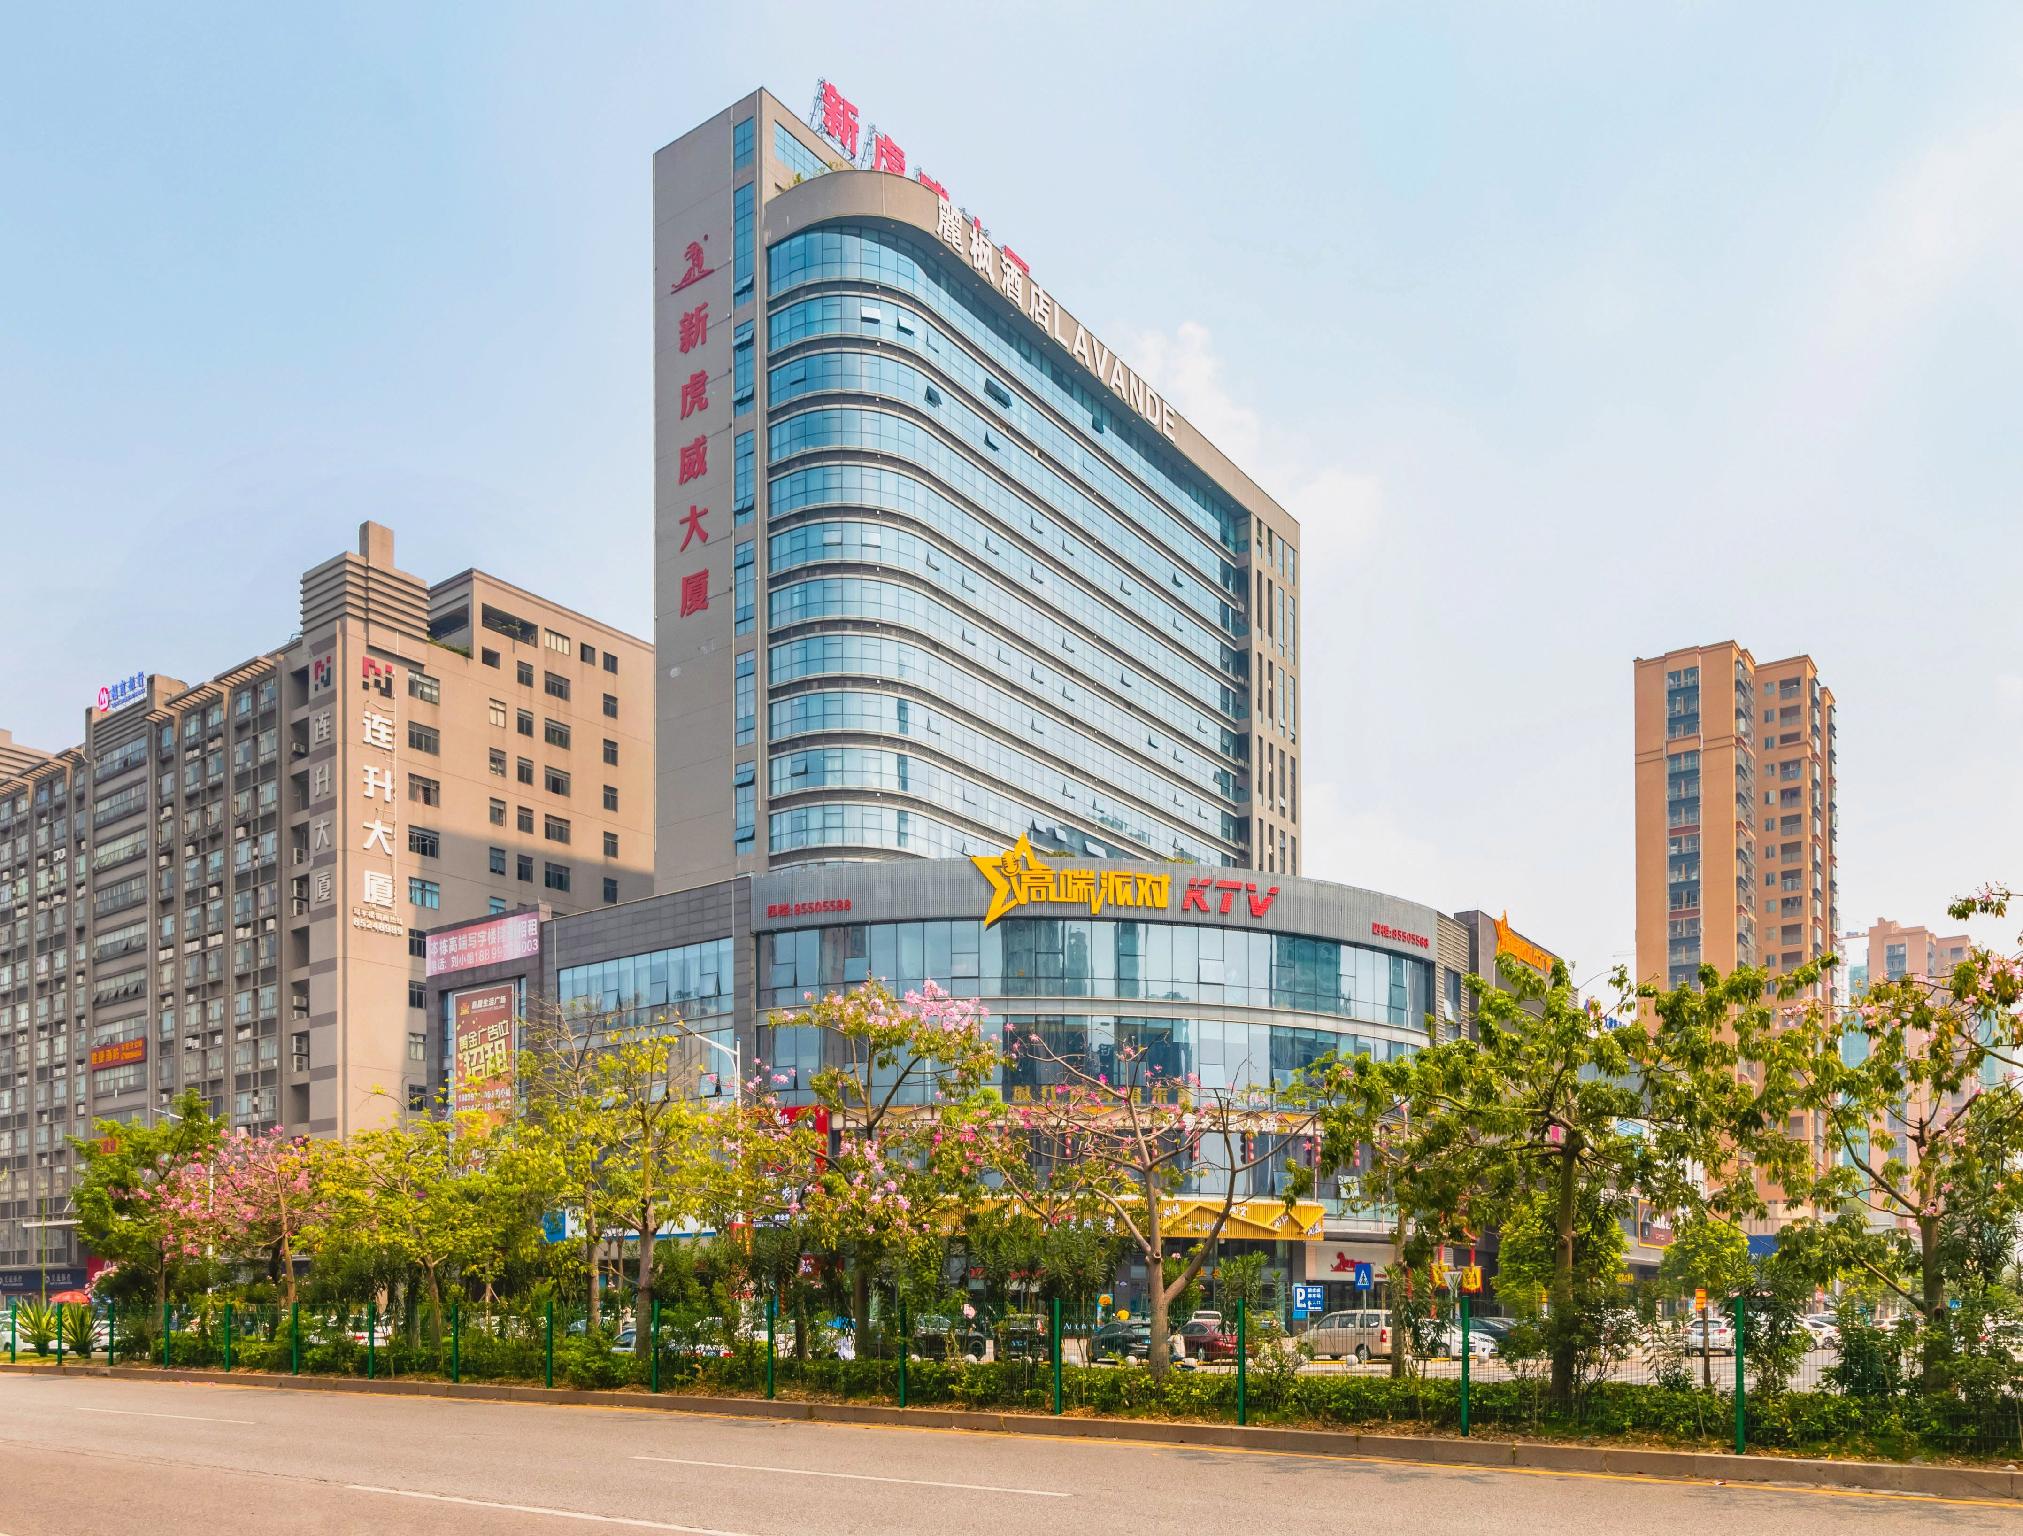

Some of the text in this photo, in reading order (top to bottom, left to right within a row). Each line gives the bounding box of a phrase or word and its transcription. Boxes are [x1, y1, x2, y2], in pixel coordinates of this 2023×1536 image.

[1053, 302, 1176, 443] LAVANDE
[679, 302, 709, 618] 新虎威大厦
[314, 711, 331, 905] 连升大厦
[362, 711, 393, 908] 连升大厦
[1018, 868, 1280, 918] 高端派对 KTV
[459, 1019, 509, 1052] 黄金广告位
[461, 1039, 508, 1080] 招租
